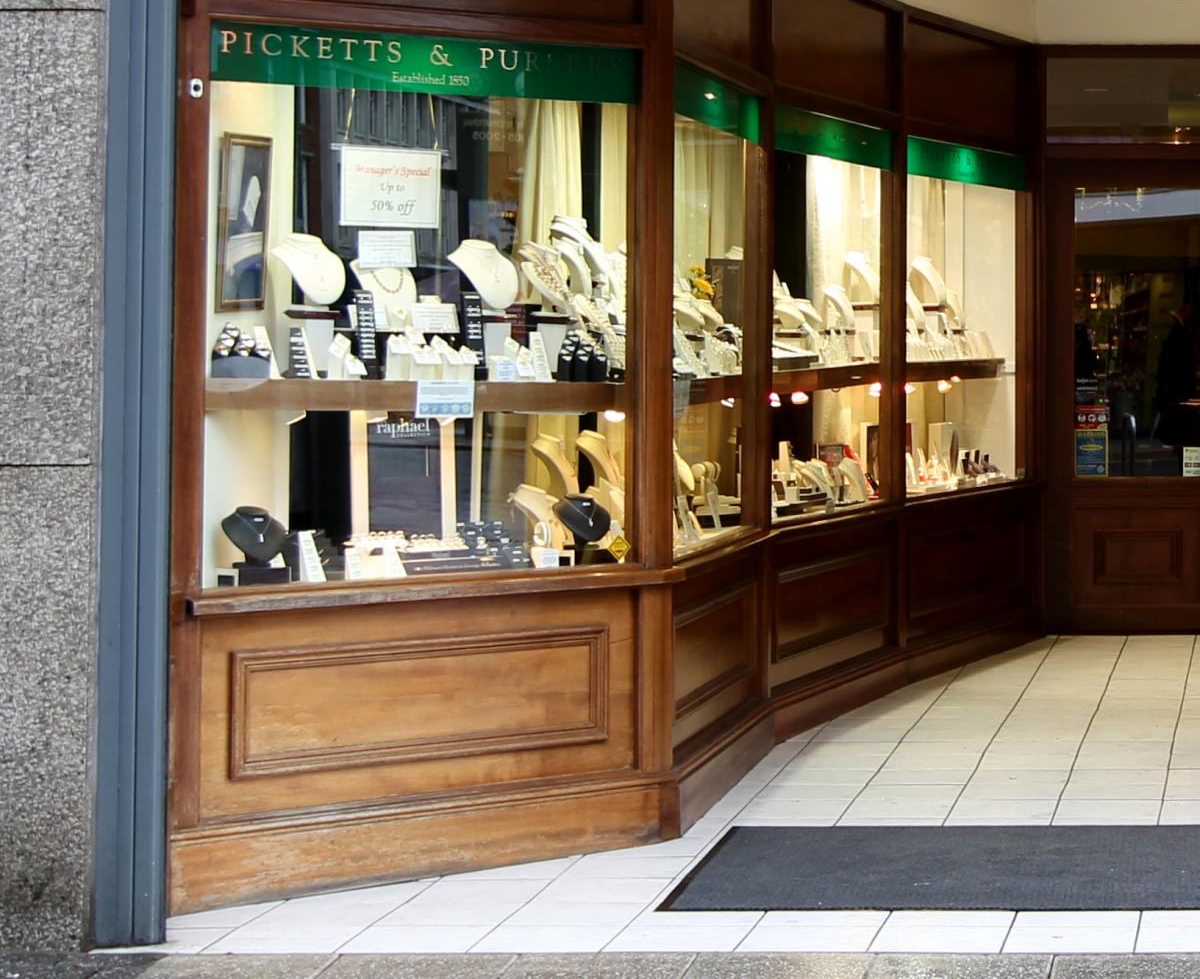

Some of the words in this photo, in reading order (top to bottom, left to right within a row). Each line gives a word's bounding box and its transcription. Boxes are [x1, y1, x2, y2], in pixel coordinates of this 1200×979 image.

[220, 29, 402, 63] PICKETTS
[429, 44, 453, 67] &
[391, 71, 446, 85] Established
[448, 74, 469, 87] 1850
[399, 166, 432, 178] Special
[379, 181, 394, 195] Up
[395, 182, 406, 192] to
[370, 199, 394, 212] 50%
[397, 199, 417, 216] off
[376, 418, 431, 438] raphael
